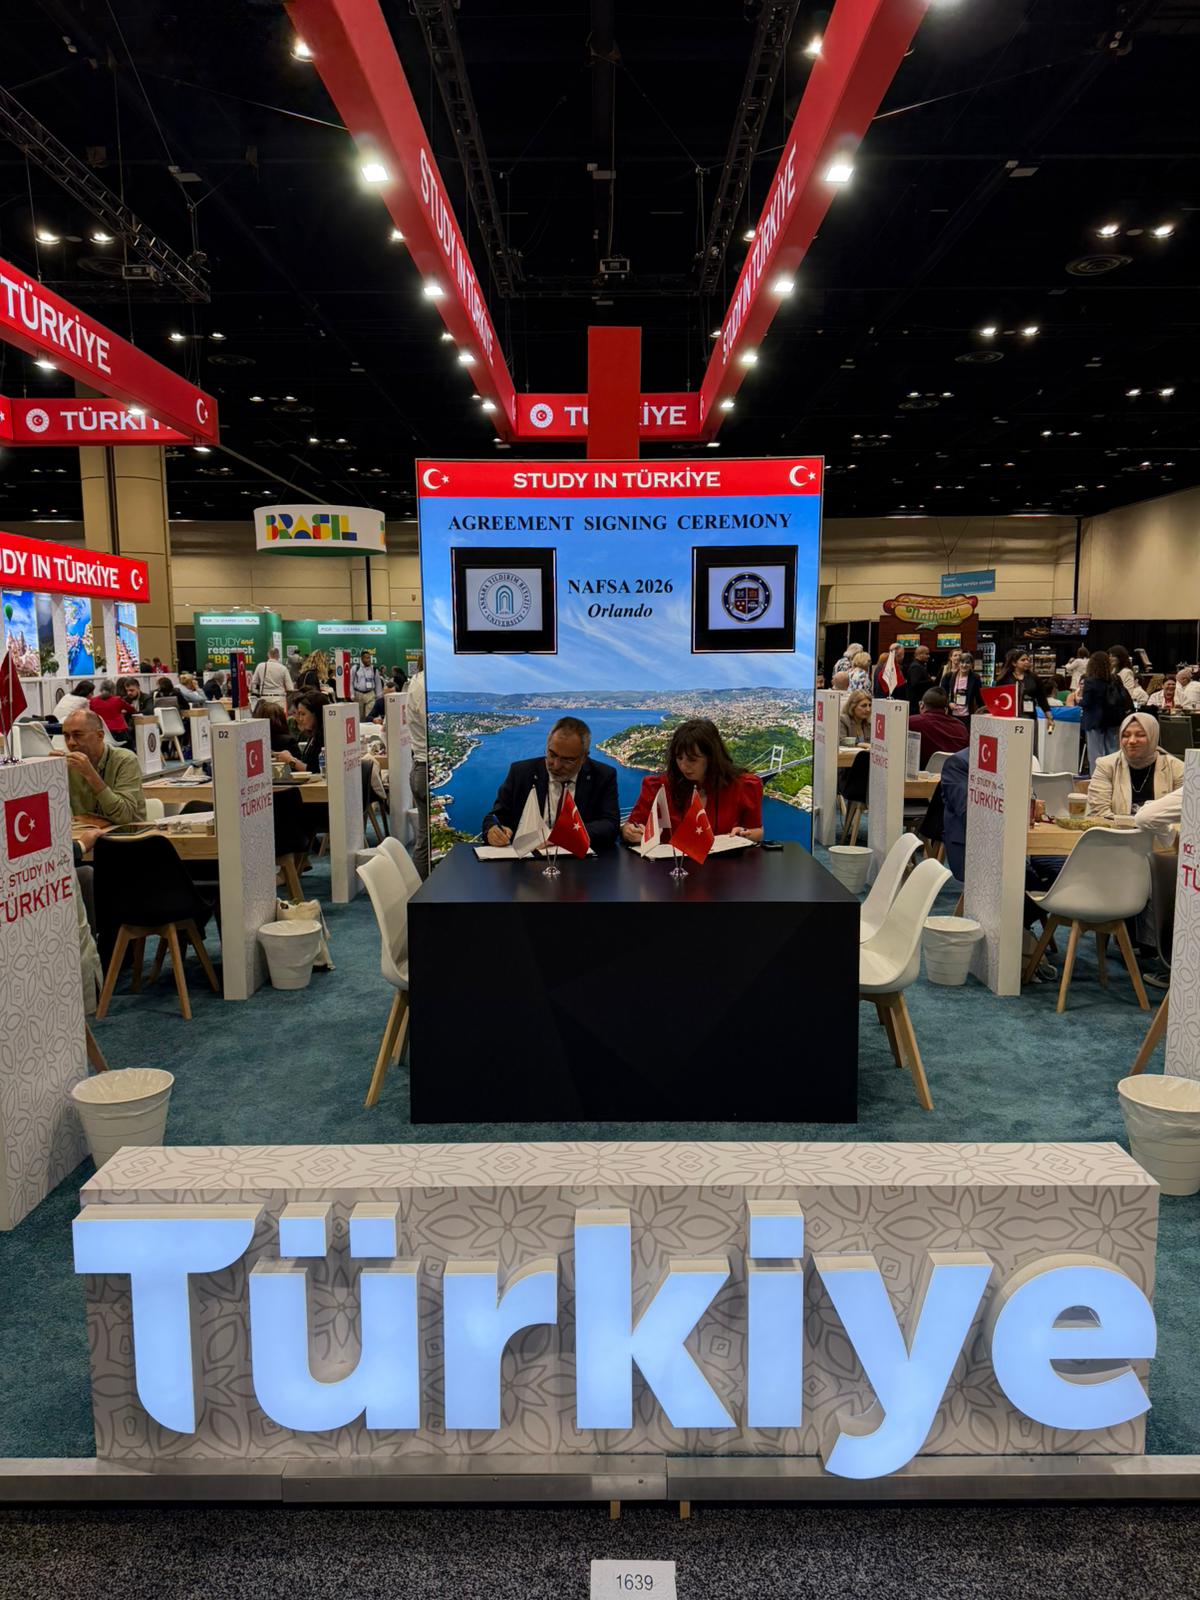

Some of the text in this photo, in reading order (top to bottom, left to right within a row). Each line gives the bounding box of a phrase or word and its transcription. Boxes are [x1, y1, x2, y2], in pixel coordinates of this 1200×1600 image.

[420, 148, 456, 269] STUDY
[456, 241, 466, 299] IN
[723, 140, 797, 365] STUDY IN TÜRKİYE
[0, 273, 112, 375] TÜRKİYE
[513, 467, 721, 489] STUDY IN TÜRKİYE
[265, 514, 358, 541] BRASIL
[448, 513, 792, 531] AGREEMENT SIGNING CEREMONY
[32, 553, 51, 580] IN
[53, 555, 120, 589] TÜRKİYE
[568, 579, 673, 594] NAFSA 2026
[588, 603, 653, 618] Orlando
[906, 605, 961, 620] Nathan's
[207, 637, 240, 647] STUDY
[218, 731, 229, 739] D2
[1014, 726, 1025, 734] F2
[241, 792, 272, 817] TÜRKİYE
[969, 786, 1004, 814] TÜRKİYE
[9, 863, 42, 888] STUDY
[44, 860, 55, 875] IN
[72, 1208, 1157, 1479] Türkiye
[616, 1574, 654, 1590] 1639
